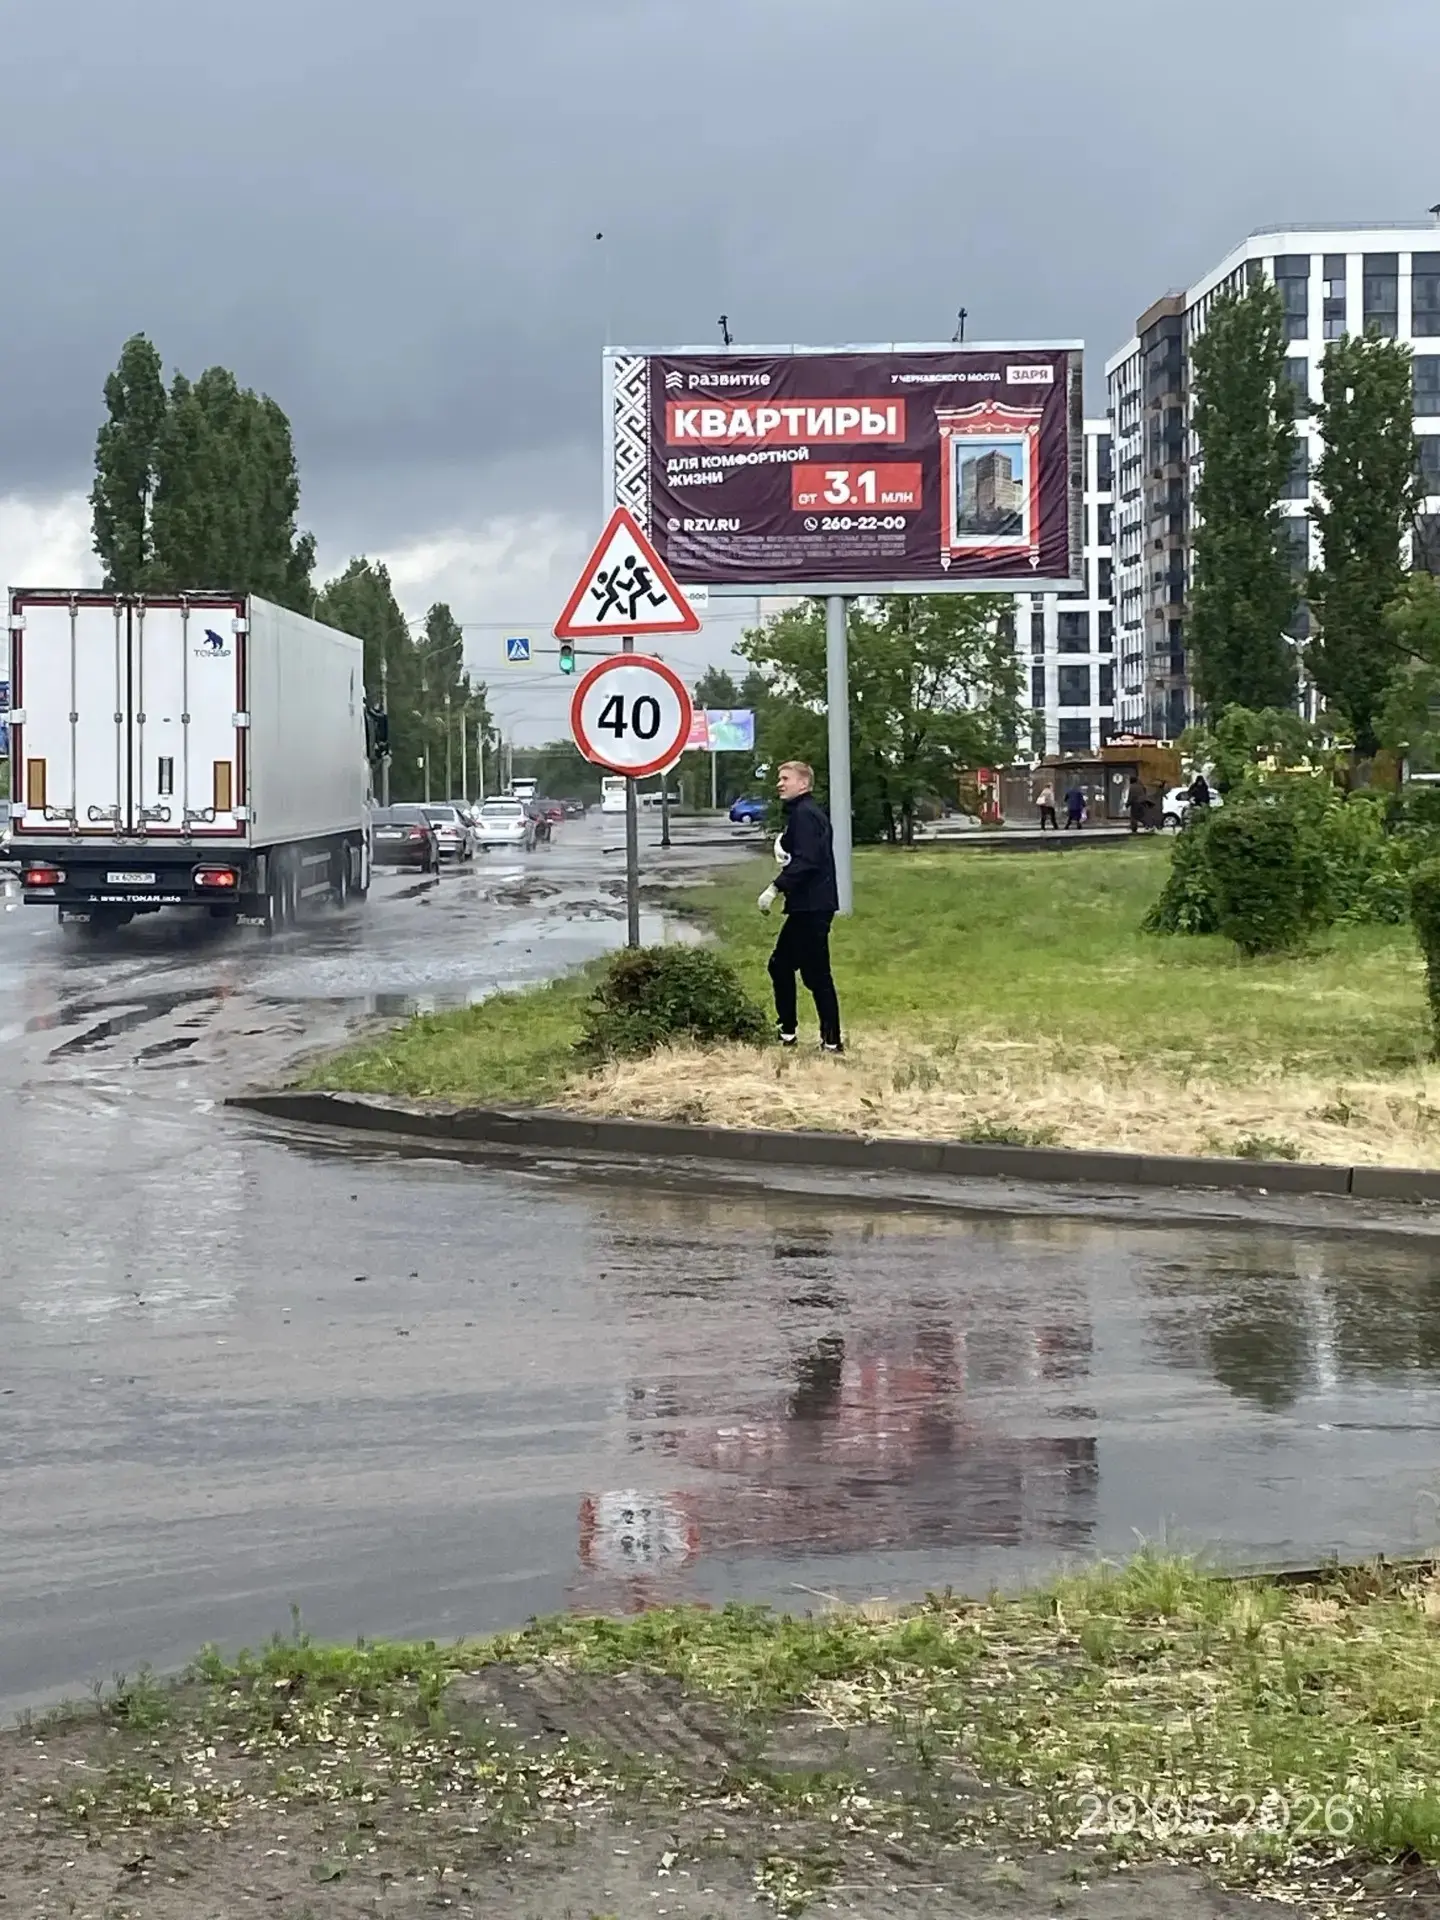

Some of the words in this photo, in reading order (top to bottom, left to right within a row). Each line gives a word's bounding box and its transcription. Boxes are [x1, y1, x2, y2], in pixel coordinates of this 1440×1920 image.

[689, 373, 771, 389] развитие
[891, 374, 898, 384] У
[968, 372, 1001, 382] МОСТА
[1012, 369, 1049, 380] ЗАРЯ
[674, 406, 897, 438] КВАРТИРЫ
[667, 456, 699, 473] ДЛЯ
[702, 447, 809, 469] КОМФОРТНОЙ
[667, 471, 723, 487] ЖИЗНИ
[823, 470, 876, 504] 3.1
[684, 518, 740, 531] RZV.RU
[822, 517, 906, 530] 260-22-00
[598, 695, 661, 740] 40
